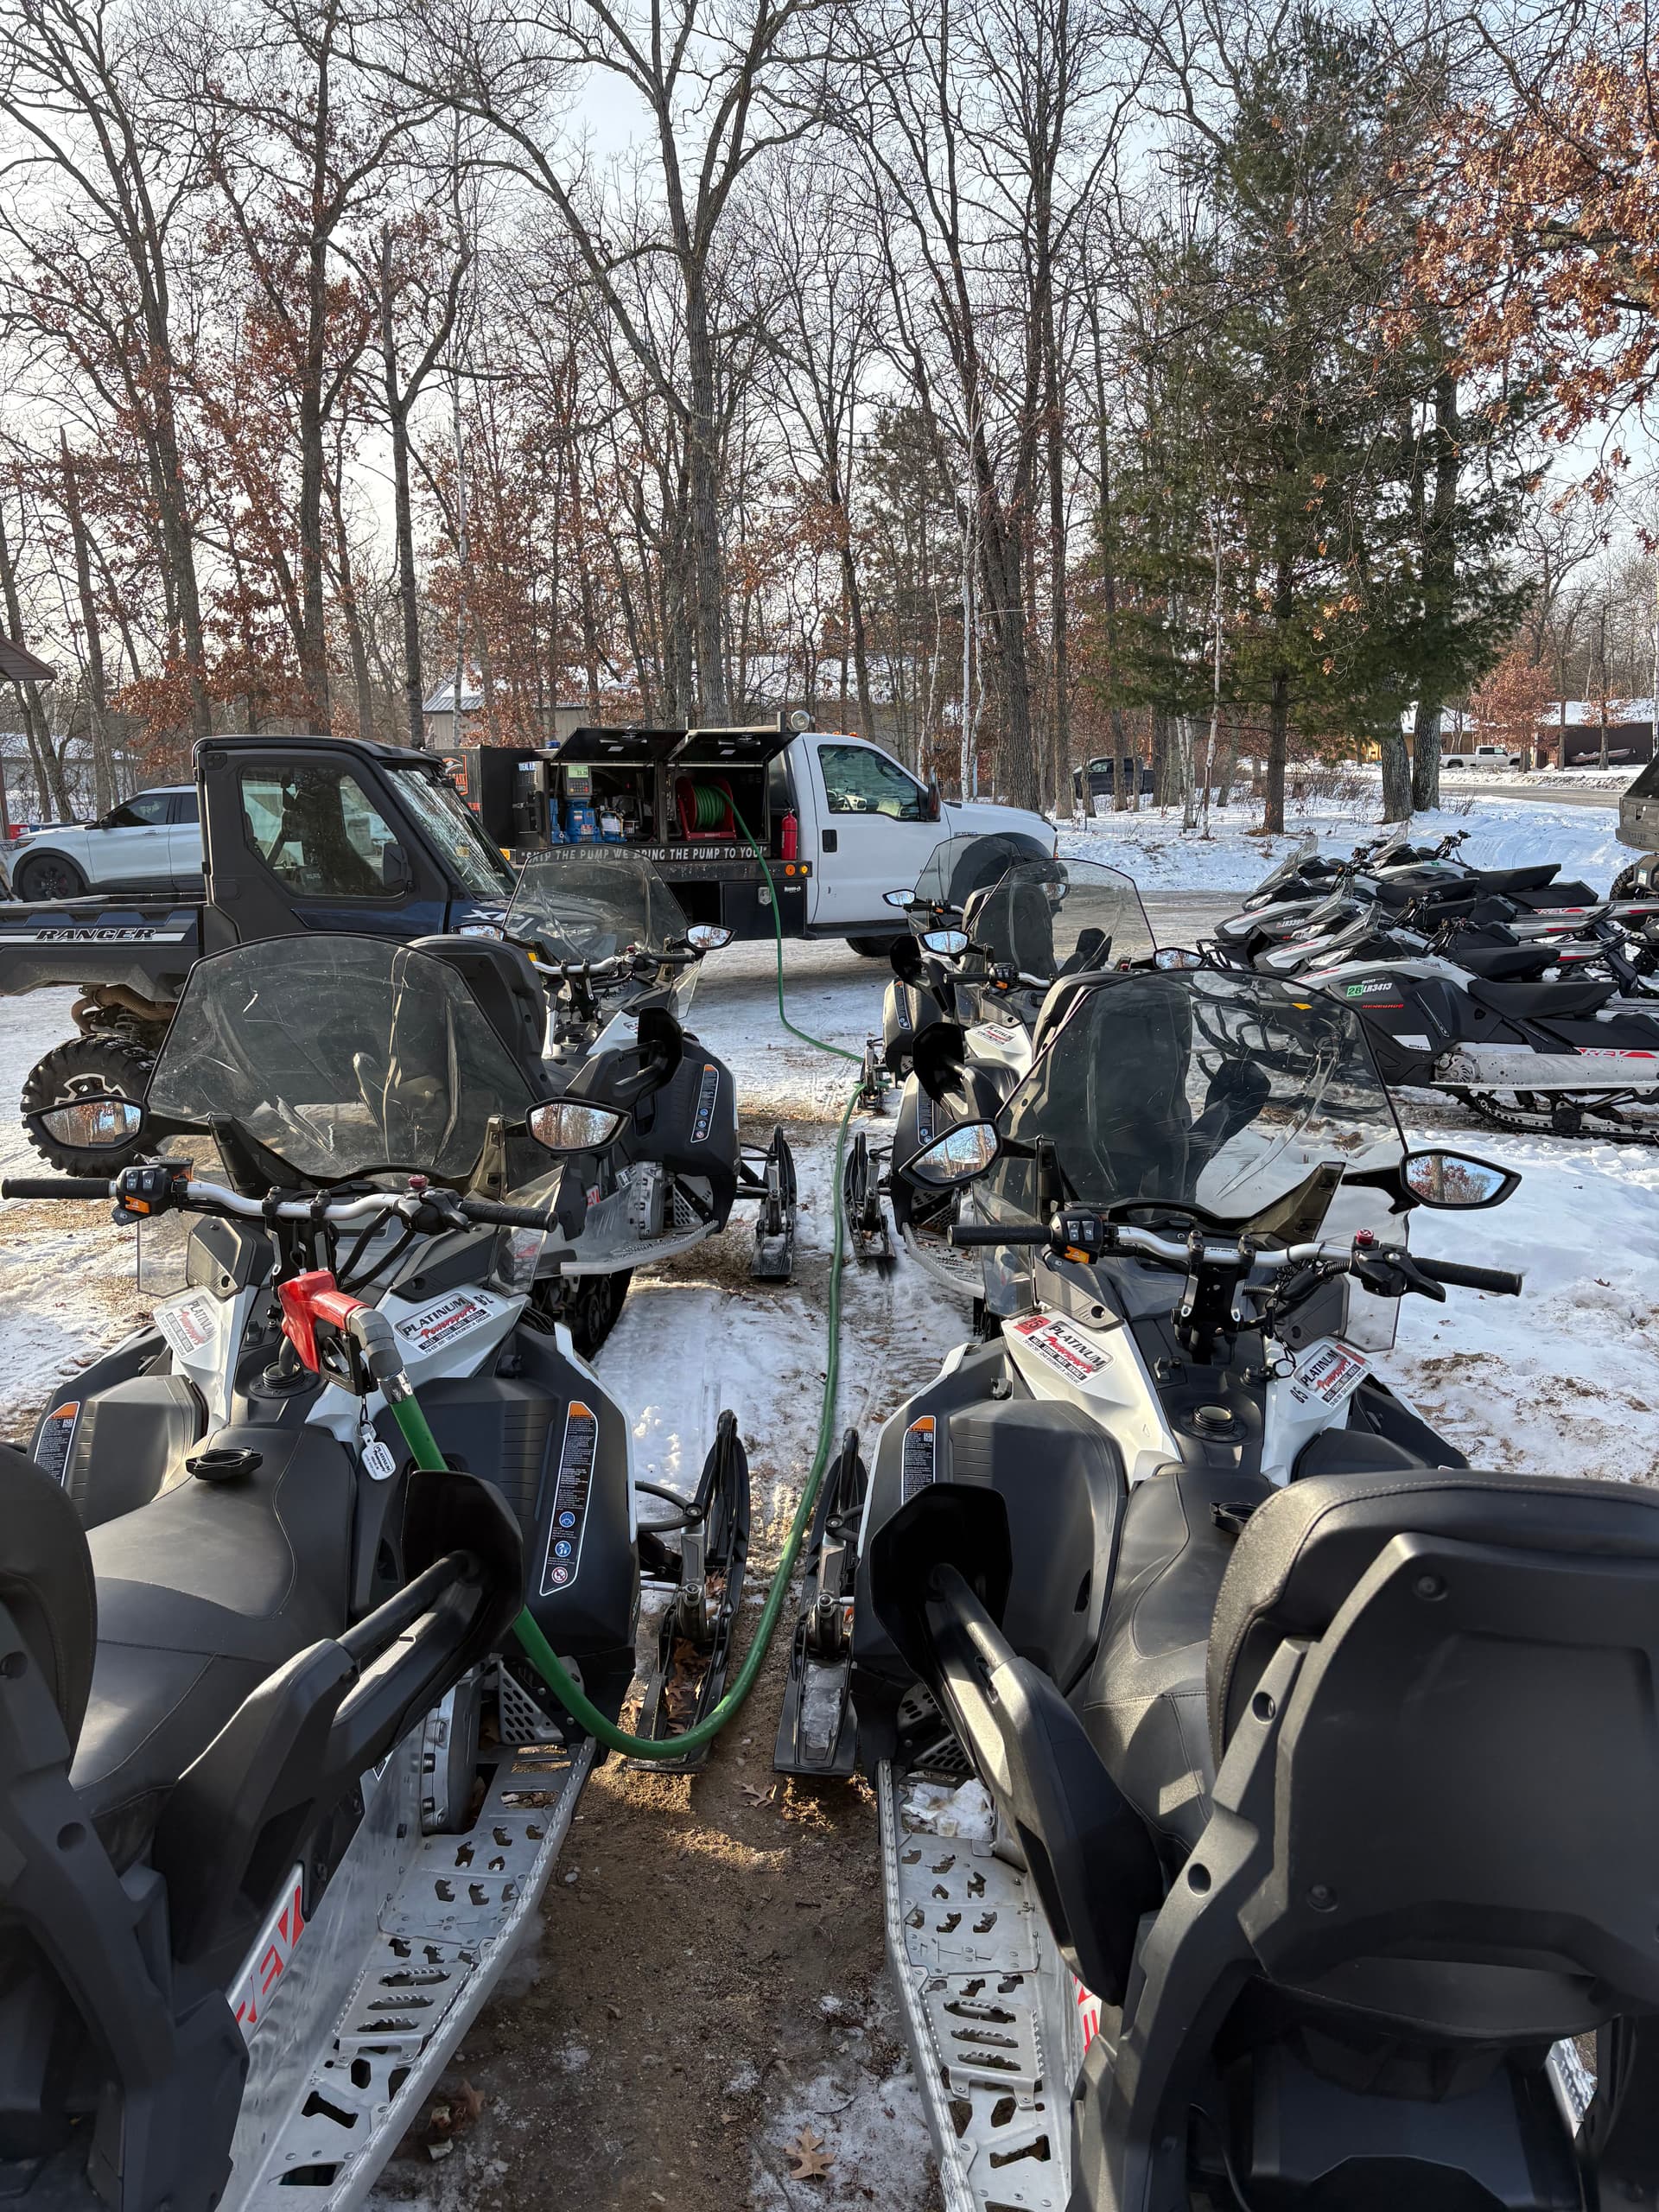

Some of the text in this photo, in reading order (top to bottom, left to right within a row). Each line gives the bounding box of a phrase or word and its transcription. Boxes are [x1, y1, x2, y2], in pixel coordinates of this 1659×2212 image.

[556, 849, 576, 860] THE
[580, 849, 609, 860] PUMP
[613, 849, 628, 859] WE
[670, 849, 689, 860] THE
[693, 849, 720, 860] PUMP
[724, 848, 736, 859] TO
[35, 927, 157, 942] RANGER
[1348, 982, 1393, 995] 28 LR3413
[191, 1300, 216, 1338] PLATINUM
[402, 1296, 467, 1337] PLATINUM
[421, 1302, 477, 1339] Powersports
[1044, 1336, 1092, 1374] Powersports
[1049, 1325, 1107, 1367] PLATINUM
[1300, 1350, 1339, 1387] PLATINUM
